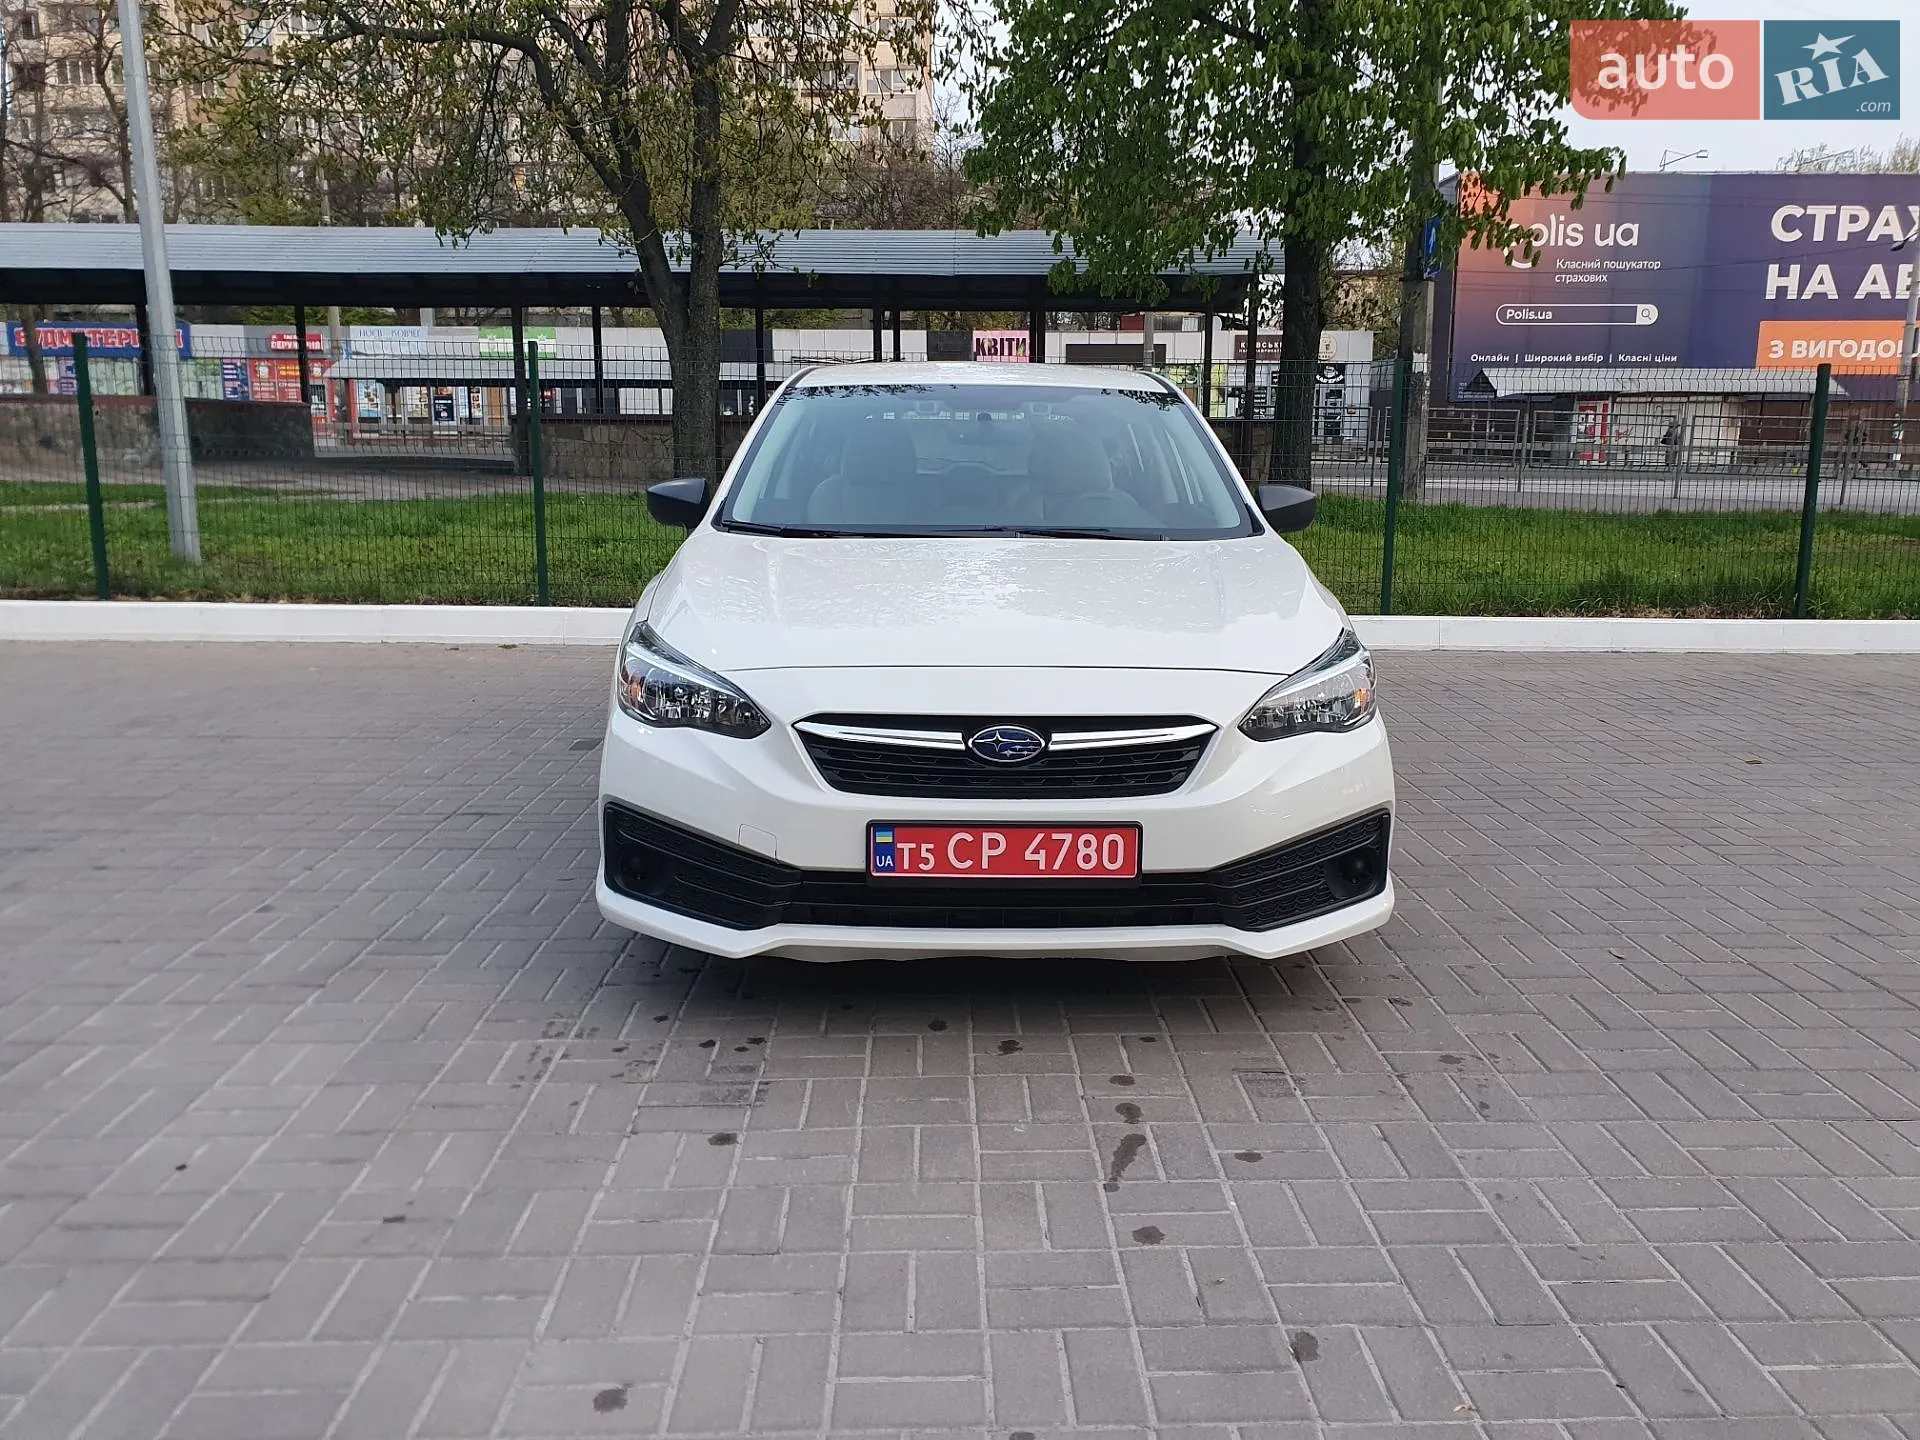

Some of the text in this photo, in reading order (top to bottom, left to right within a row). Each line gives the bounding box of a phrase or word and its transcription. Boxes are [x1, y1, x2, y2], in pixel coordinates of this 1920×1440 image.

[1594, 222, 1640, 248] ua
[1556, 258, 1661, 271] Класний пошукатор
[1555, 273, 1608, 284] страхових
[1765, 263, 1839, 300] НА
[1506, 309, 1553, 321] Polis.ua
[975, 337, 1027, 357] КВІТИ
[1470, 353, 1510, 363] Онлайн
[1524, 353, 1604, 364] Широкий вибір
[1618, 353, 1678, 364] Класні ціни
[876, 855, 894, 868] UA
[947, 832, 1007, 870] CP
[1024, 832, 1126, 871] 4780
